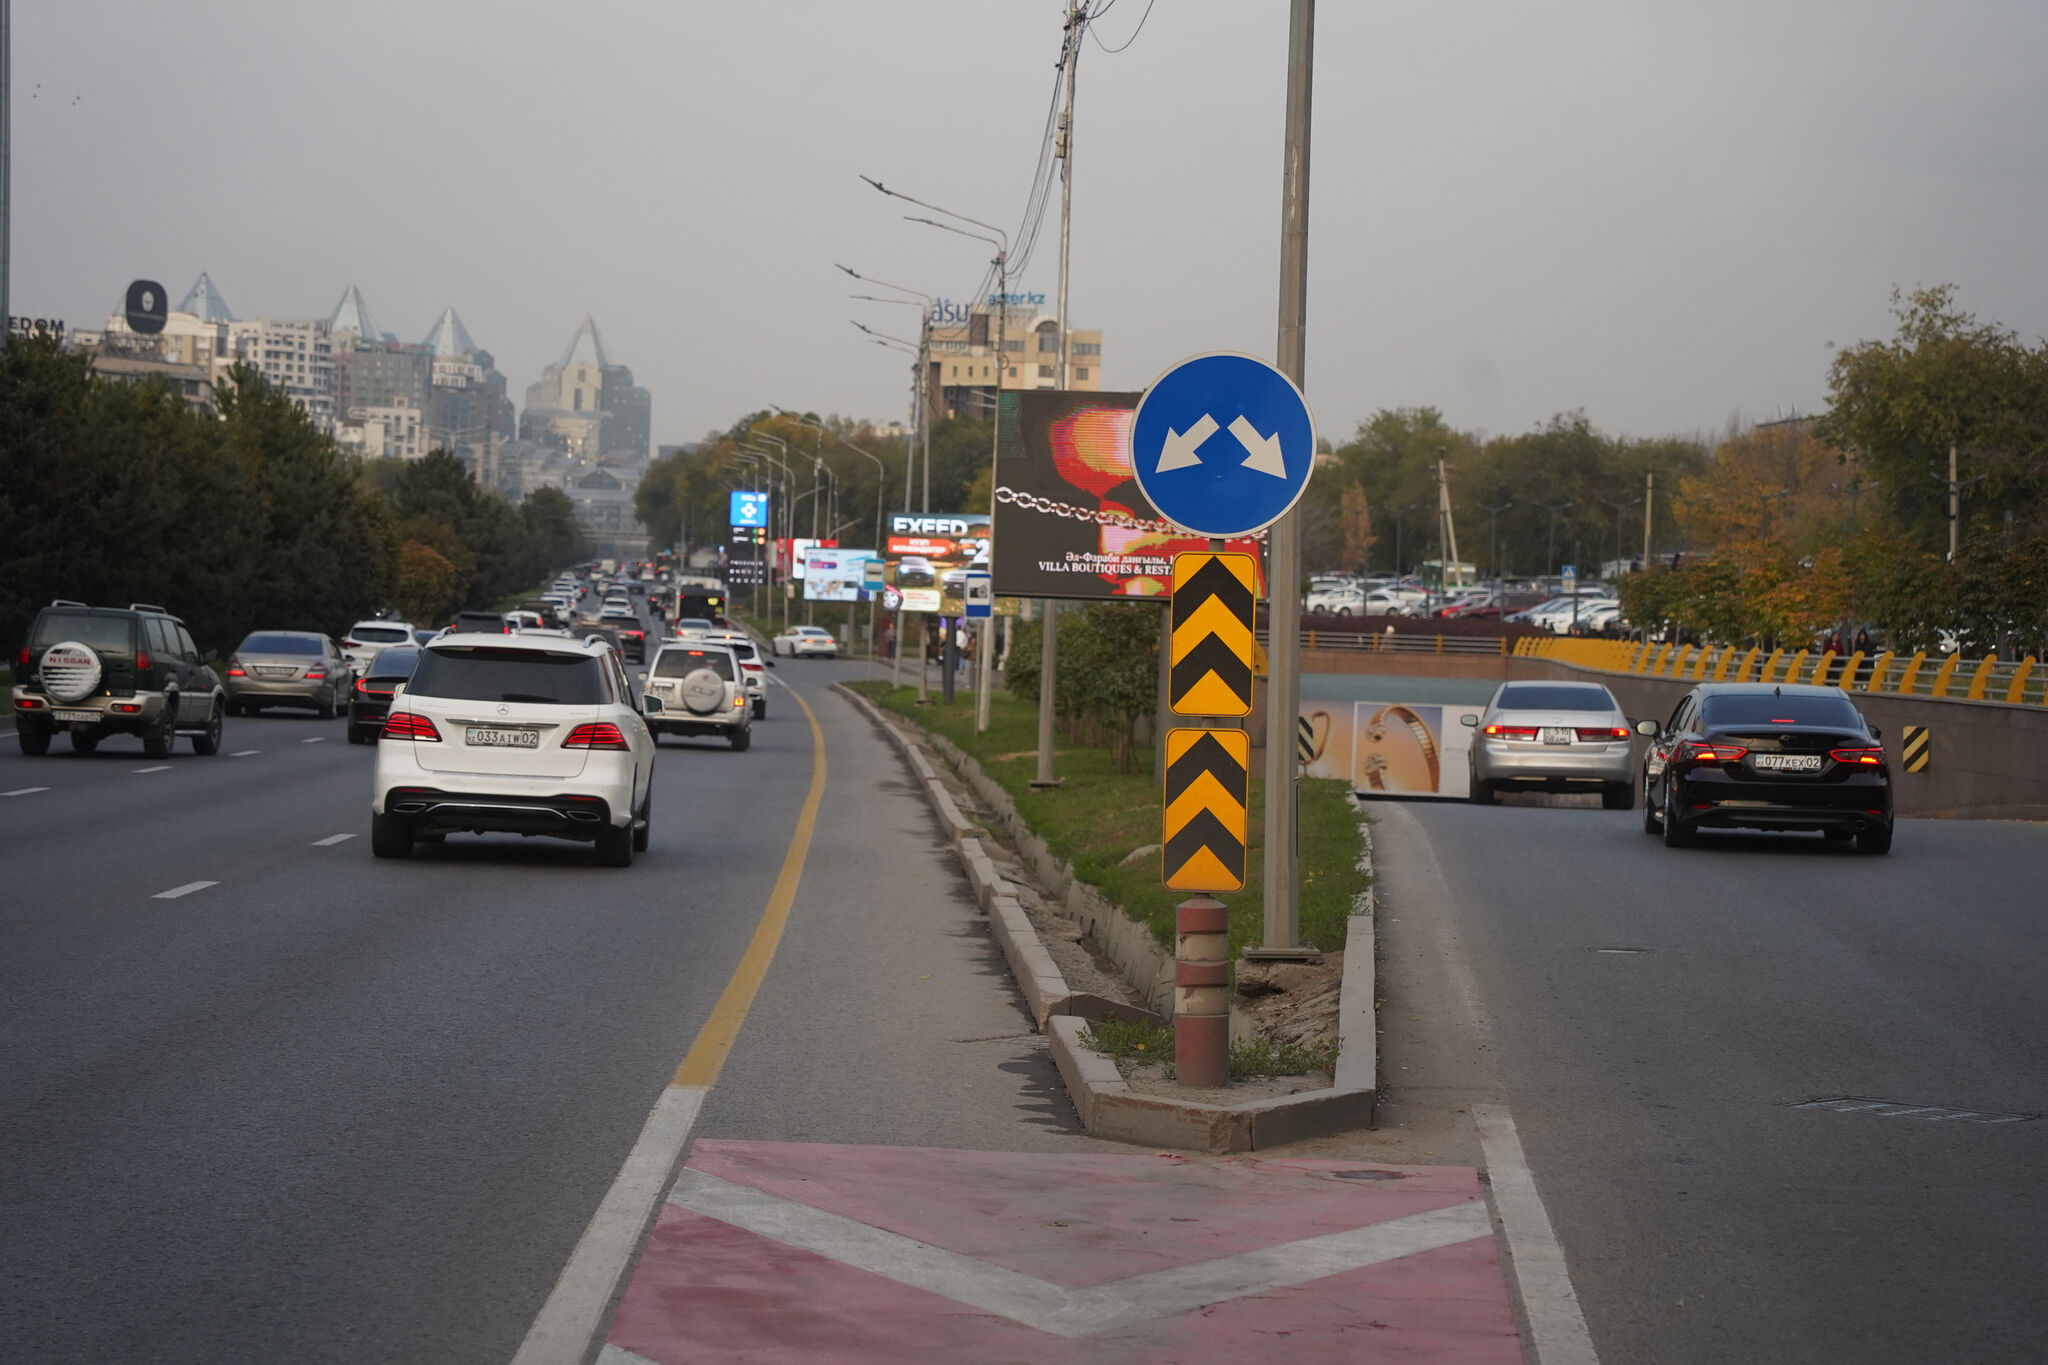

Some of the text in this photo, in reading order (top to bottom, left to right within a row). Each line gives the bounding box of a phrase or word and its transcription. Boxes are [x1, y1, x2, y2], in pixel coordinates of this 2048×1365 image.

[893, 517, 968, 535] EXEED
[1038, 561, 1070, 572] VILLA
[1071, 562, 1132, 575] BOUTIQUES
[1133, 565, 1143, 575] &
[49, 657, 91, 665] NISSAN
